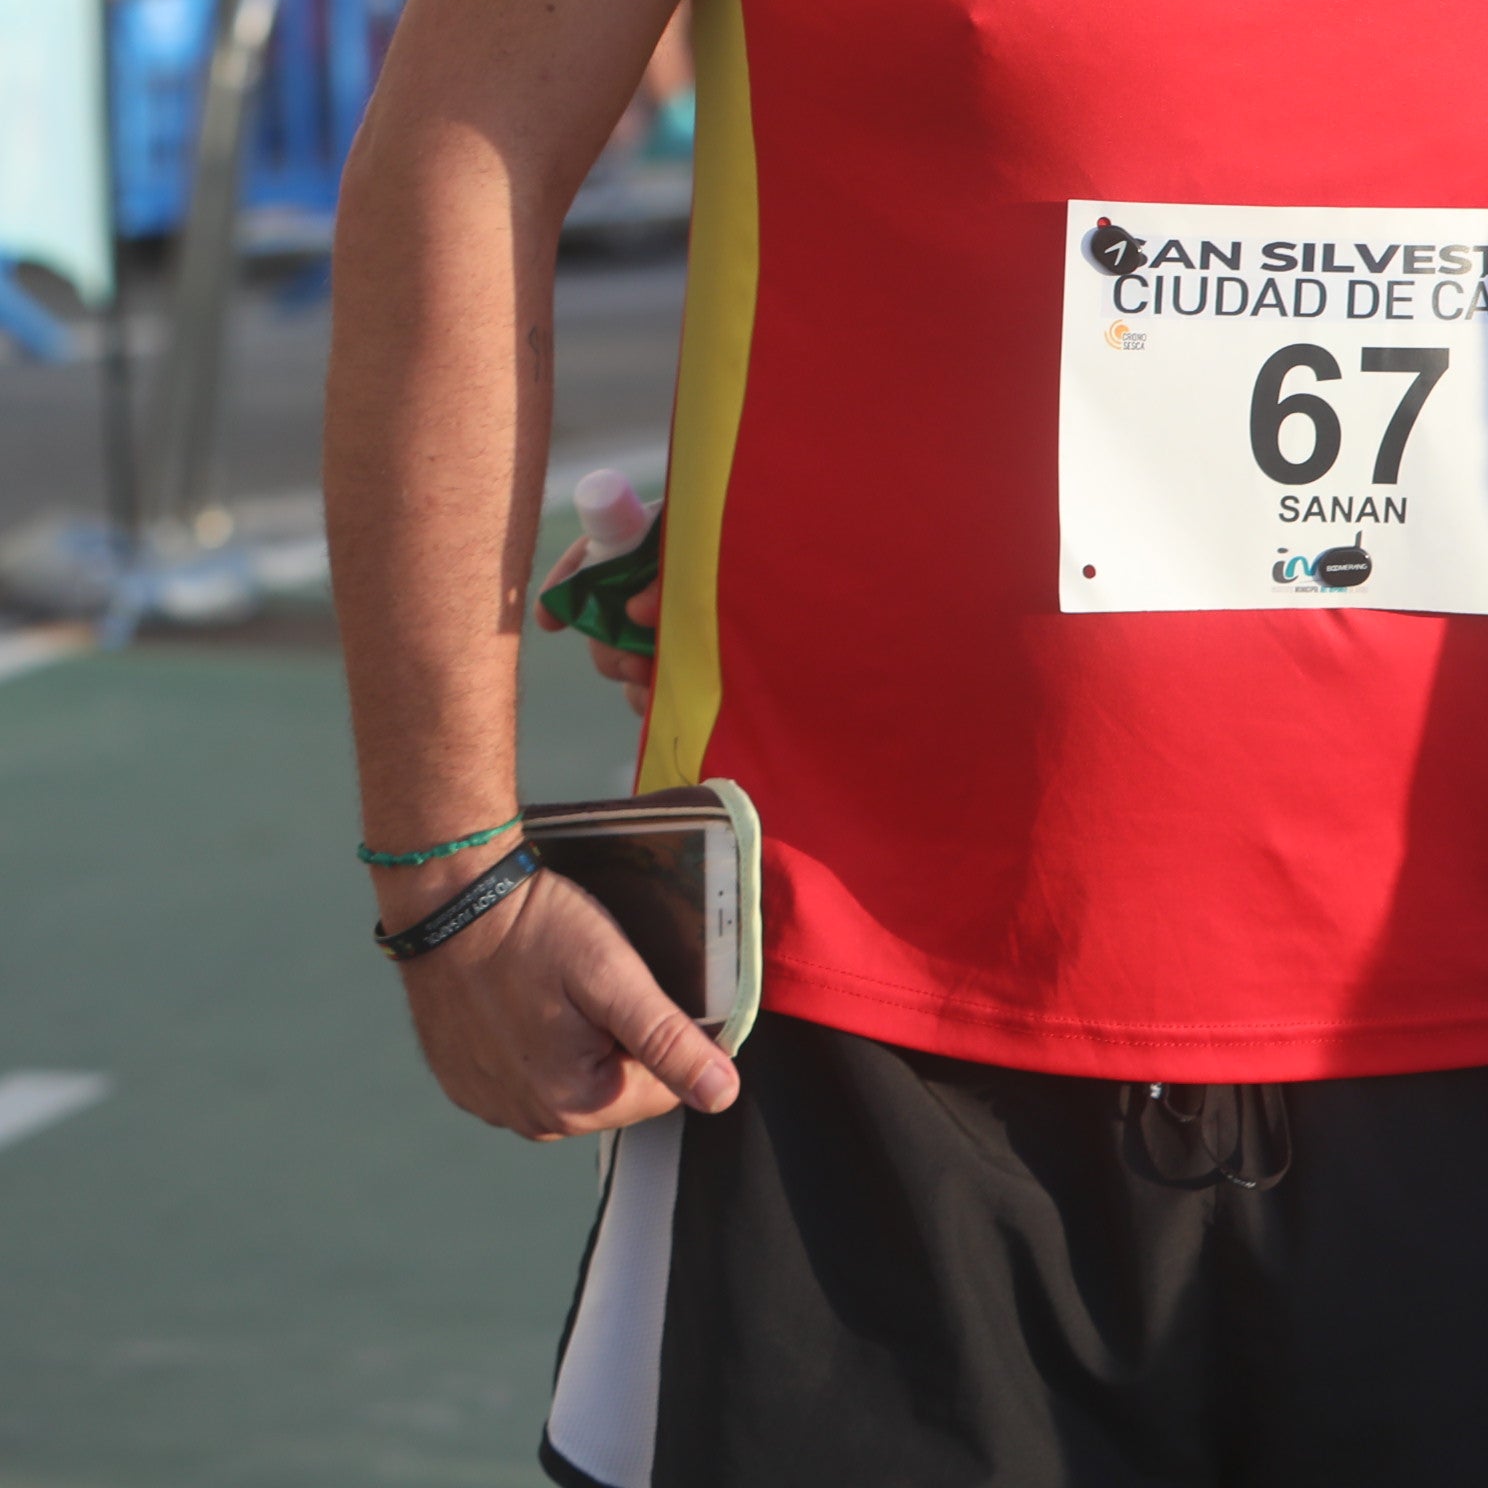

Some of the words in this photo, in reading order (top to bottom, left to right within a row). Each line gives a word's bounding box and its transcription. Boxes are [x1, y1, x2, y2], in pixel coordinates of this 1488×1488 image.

[1113, 274, 1327, 318] CIUDAD
[1346, 279, 1416, 321] DE
[1250, 343, 1450, 486] 67
[1278, 495, 1408, 525] SANAN
